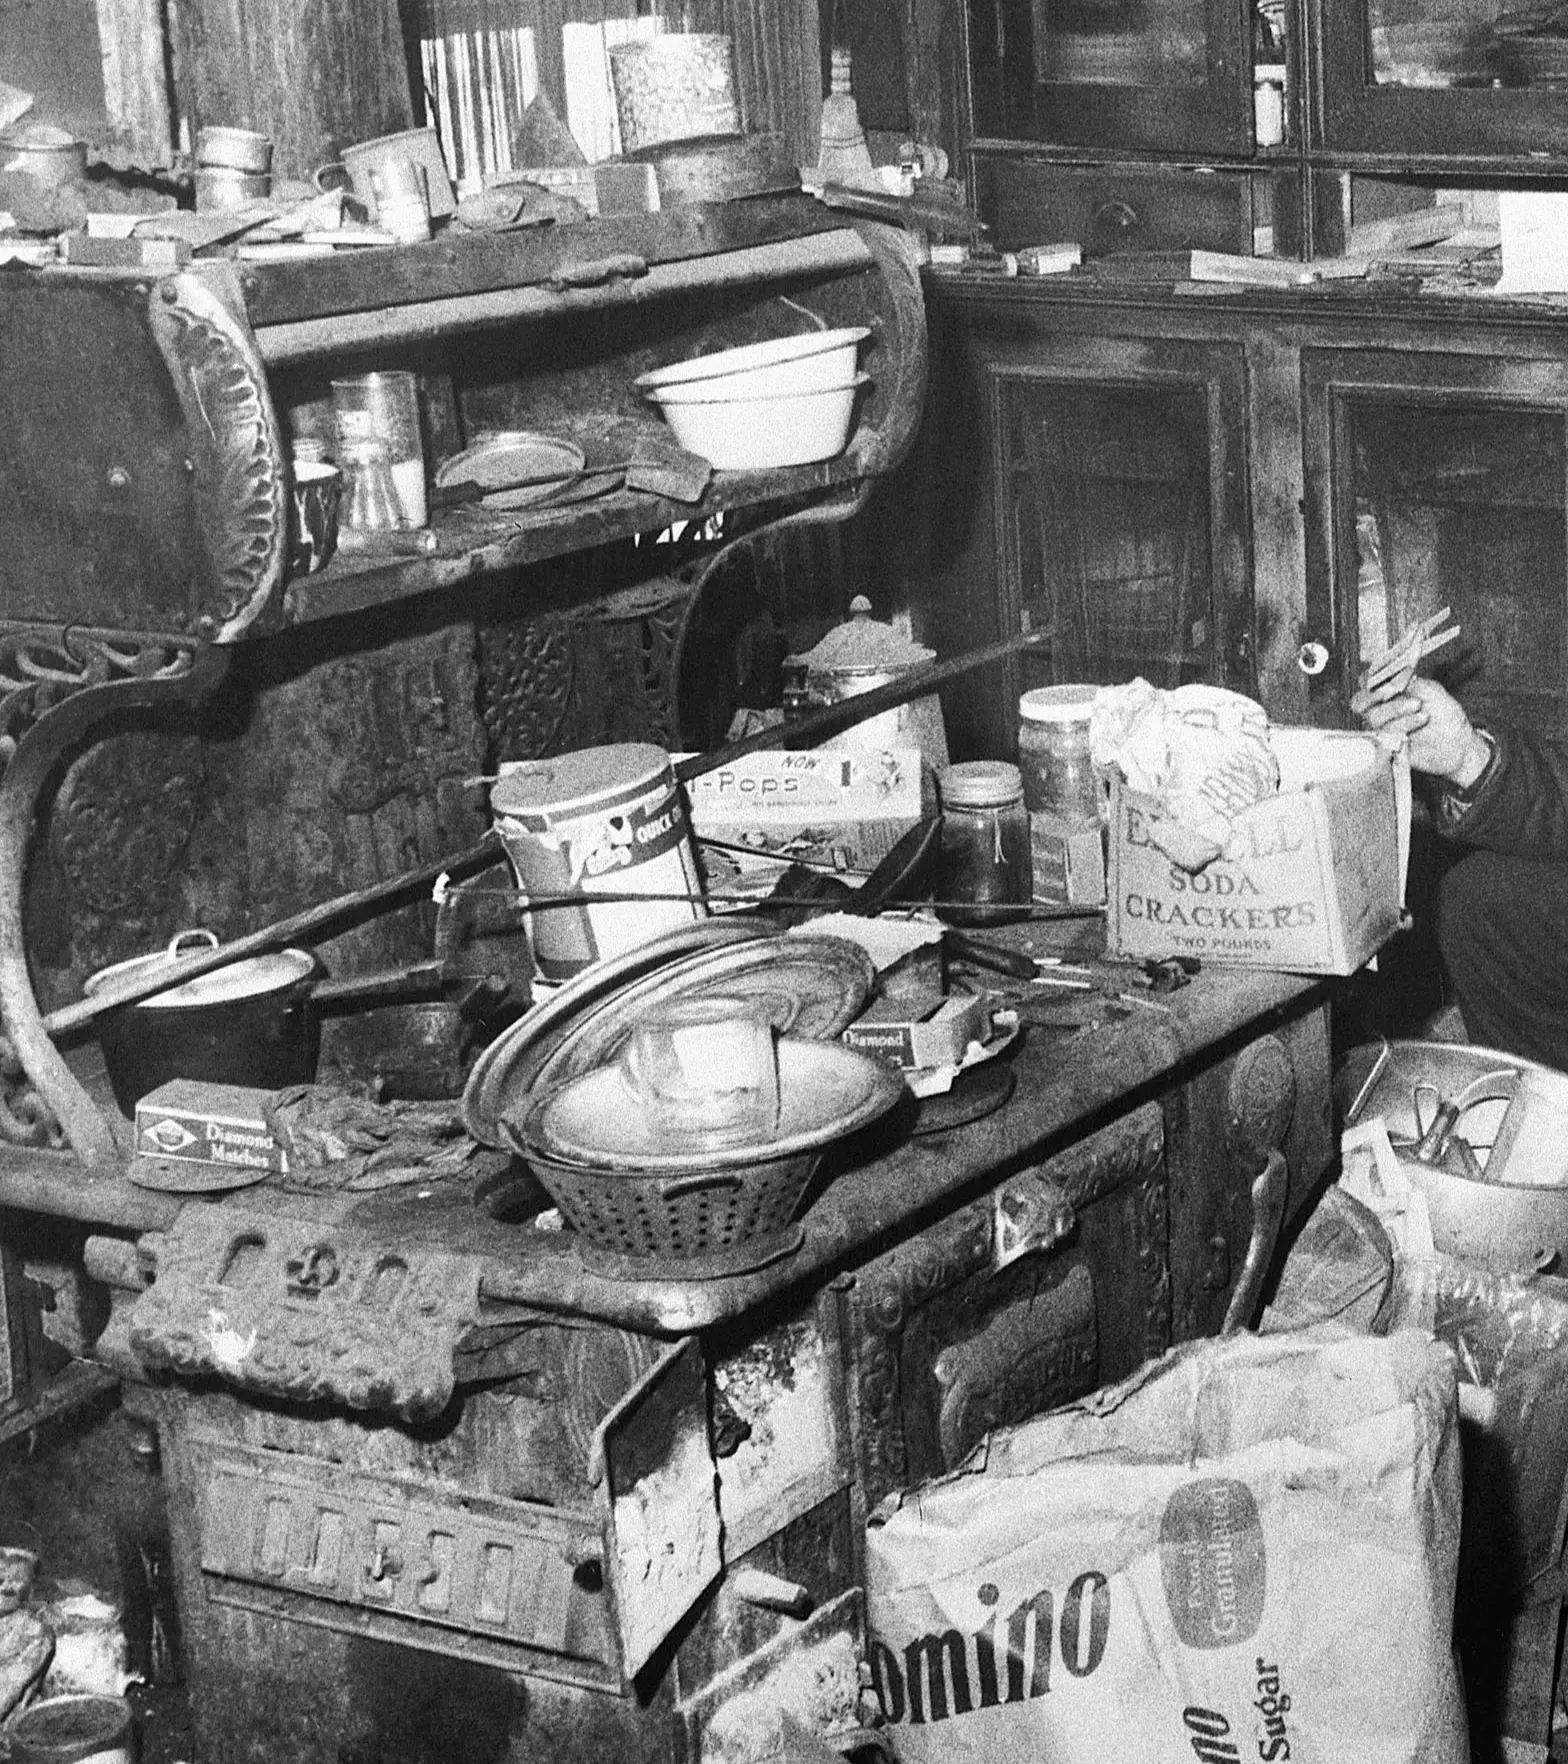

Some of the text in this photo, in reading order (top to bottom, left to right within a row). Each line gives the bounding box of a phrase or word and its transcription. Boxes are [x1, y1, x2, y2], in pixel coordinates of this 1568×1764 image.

[781, 755, 820, 769] NOW
[635, 813, 673, 844] QUICK
[1168, 867, 1260, 897] SODA
[1124, 893, 1318, 930] CRACKERS
[1172, 935, 1272, 951] TWO POUNDS
[842, 1030, 904, 1047] Diamond
[206, 1122, 274, 1149] Diamond
[211, 1143, 270, 1168] Matches
[869, 1571, 1111, 1724] omino
[1253, 1657, 1292, 1762] Sugar
